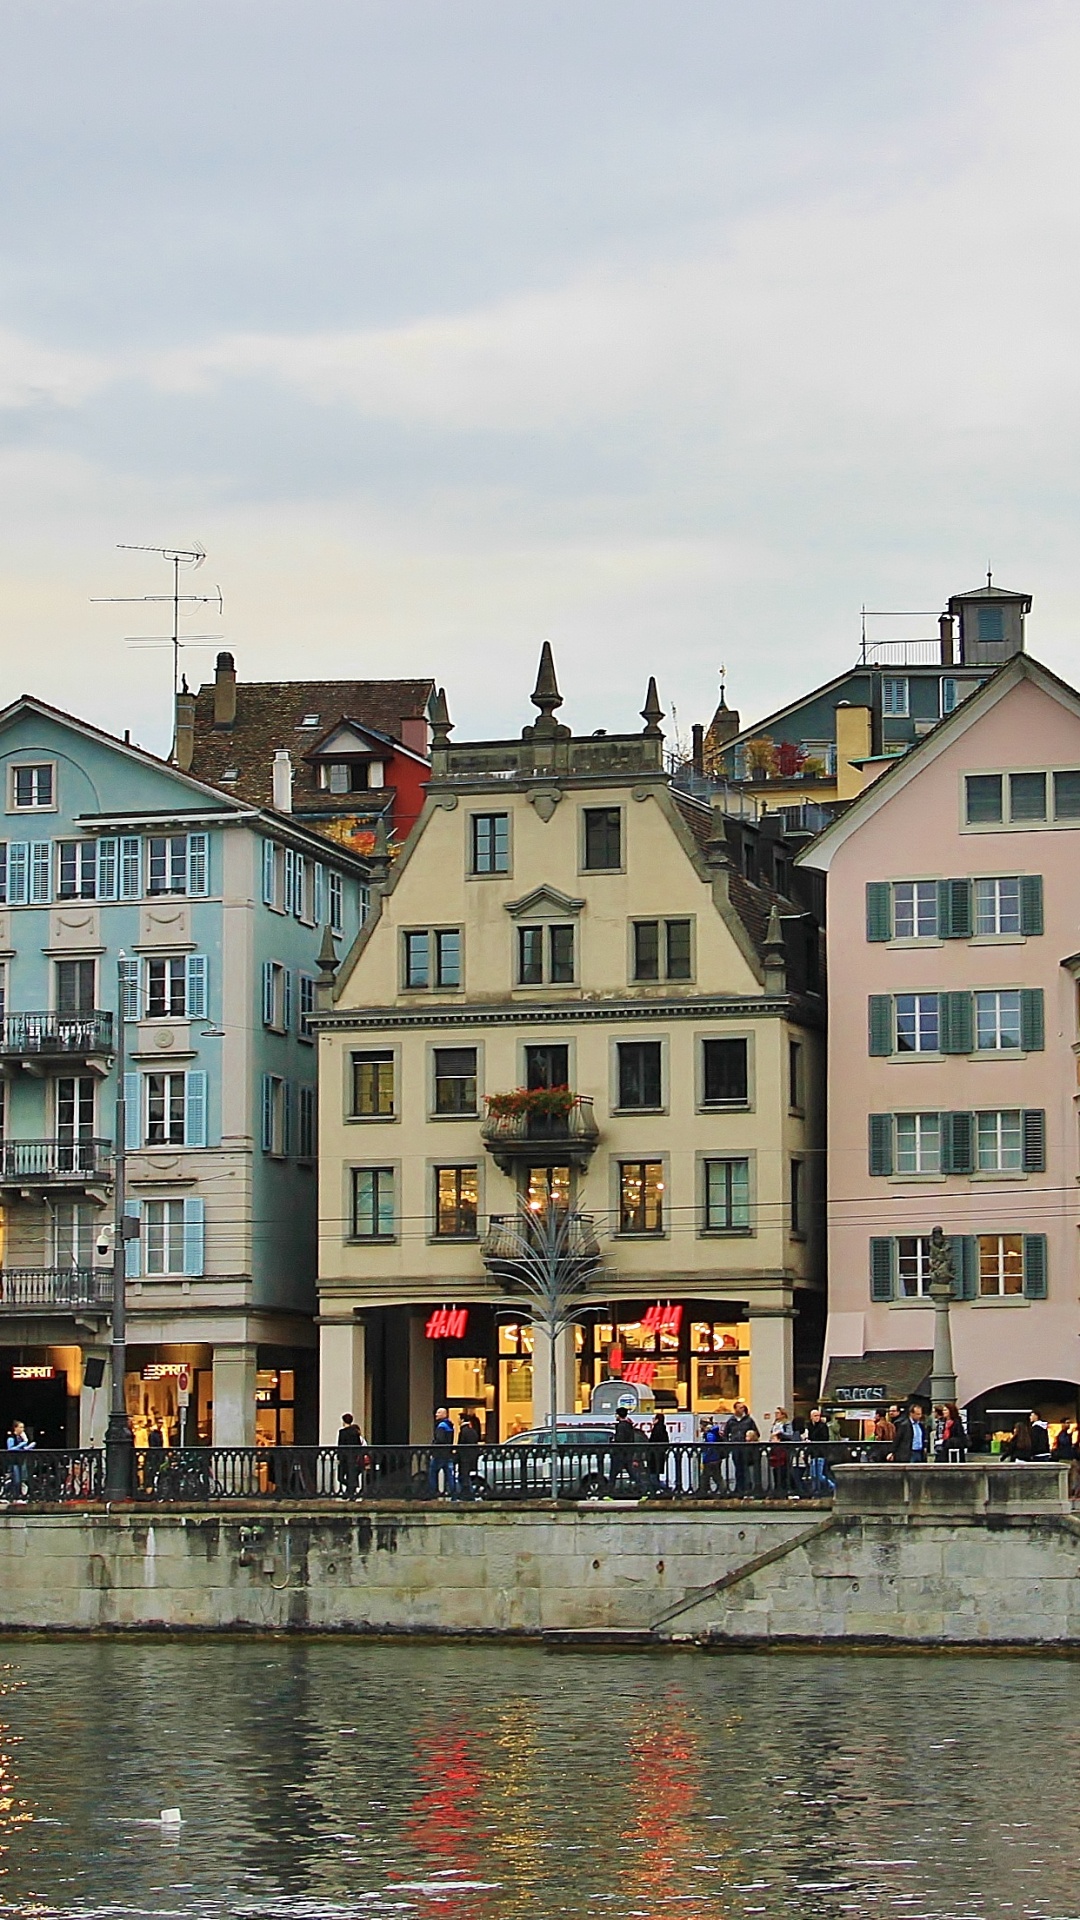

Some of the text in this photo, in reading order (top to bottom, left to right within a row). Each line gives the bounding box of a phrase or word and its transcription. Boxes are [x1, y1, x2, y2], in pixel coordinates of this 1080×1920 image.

[425, 1309, 469, 1339] H&M
[641, 1305, 683, 1335] H&M
[12, 1366, 54, 1379] ESPRIT
[145, 1364, 188, 1376] ESPRIT
